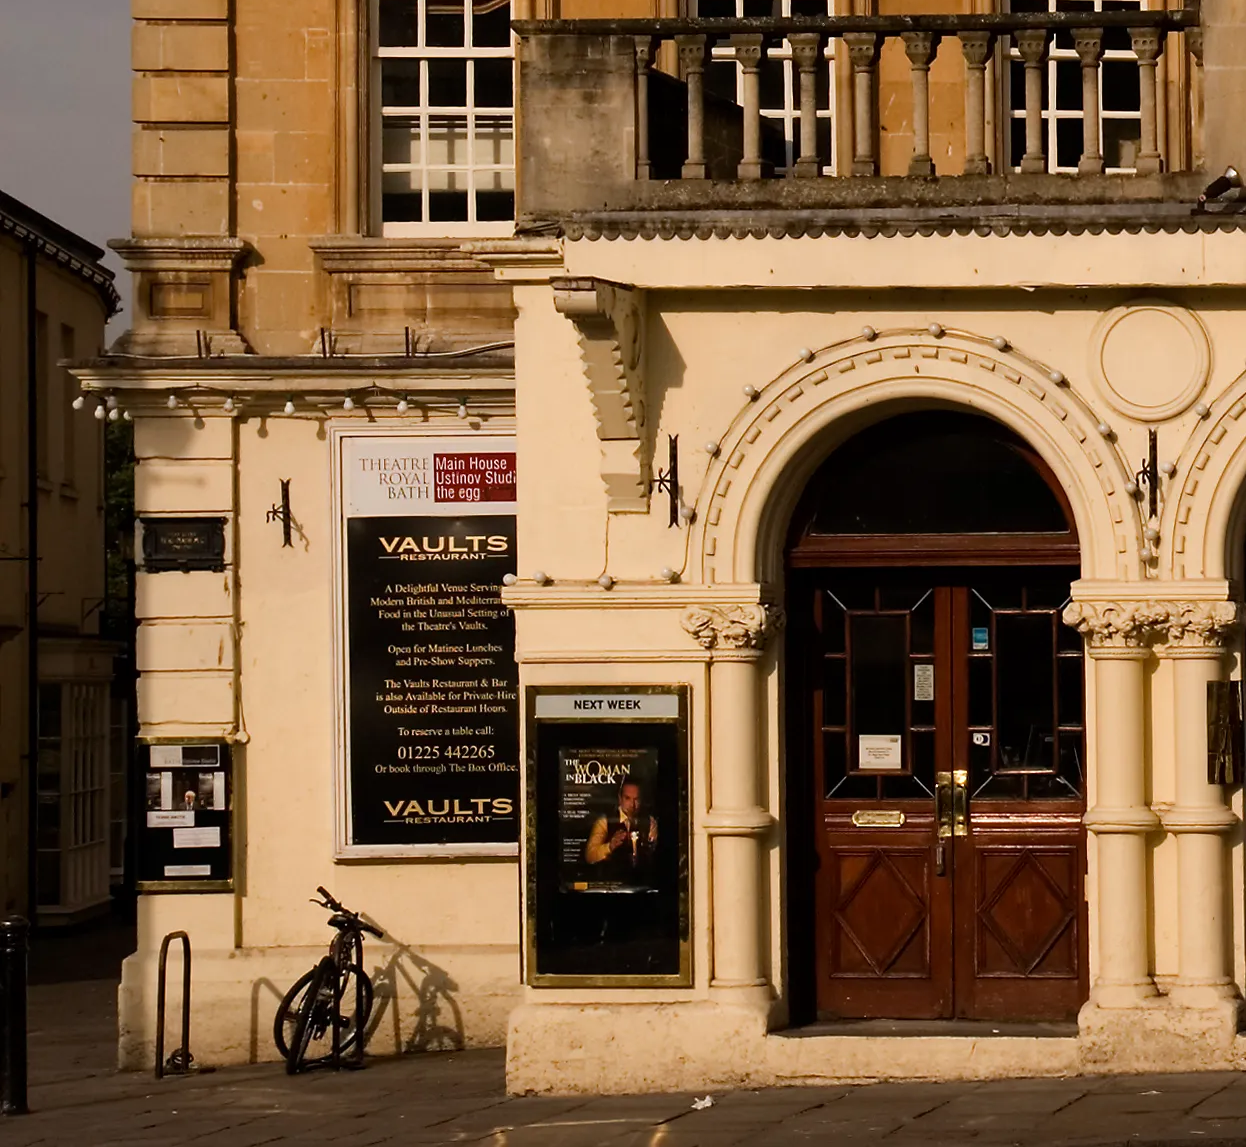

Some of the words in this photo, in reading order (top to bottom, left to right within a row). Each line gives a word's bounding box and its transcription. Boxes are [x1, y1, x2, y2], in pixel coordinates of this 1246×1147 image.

[359, 457, 429, 471] THEATRE
[436, 457, 465, 470] Main
[469, 456, 507, 470] House
[379, 472, 429, 485] ROYAL
[436, 471, 481, 485] Ustinov
[485, 470, 516, 484] Studi
[388, 486, 429, 499] BATH
[437, 486, 454, 499] the
[458, 488, 480, 501] egg
[378, 535, 508, 552] VAULTS
[400, 553, 487, 561] RESTAURANT
[385, 584, 392, 593] A
[395, 584, 438, 595] Delightful
[441, 584, 468, 593] Venue
[370, 597, 404, 606] Modern
[407, 596, 436, 605] British
[438, 596, 453, 605] and
[378, 610, 400, 619] Food
[403, 609, 411, 618] in
[413, 609, 427, 618] the
[429, 609, 465, 618] Unusual
[467, 608, 498, 619] Setting
[500, 608, 509, 617] of
[402, 622, 415, 631] the
[418, 621, 456, 631] Theatre's
[459, 621, 488, 630] Vaults.
[387, 645, 411, 655] Open
[414, 644, 426, 653] for
[428, 644, 463, 653] Matinee
[466, 643, 503, 652] Lunches
[395, 657, 411, 666] and
[413, 657, 455, 666] Pre-Show
[457, 656, 495, 667] Suppers.
[384, 679, 401, 688] The
[404, 679, 430, 688] Vaults
[432, 679, 478, 688] Restaurant
[480, 678, 488, 687] &
[492, 678, 507, 687] Bar
[375, 692, 383, 701] is
[385, 692, 403, 701] also
[405, 691, 446, 701] Available
[448, 691, 461, 700] for
[383, 705, 417, 714] Outside
[420, 704, 429, 713] of
[431, 704, 477, 713] Restaurant
[479, 704, 507, 713] Hours.
[574, 699, 604, 710] NEXT
[607, 699, 641, 710] WEEK
[397, 727, 409, 736] To
[452, 727, 473, 736] table
[475, 726, 494, 735] call:
[397, 746, 440, 759] 01225
[444, 745, 495, 759] 442265
[375, 764, 387, 773] Or
[389, 763, 411, 773] book
[413, 763, 446, 775] through
[449, 763, 466, 772] The
[468, 763, 486, 772] Box
[488, 762, 518, 772] Office.
[575, 760, 631, 778] WOMAN
[575, 773, 616, 784] BLACK
[383, 798, 513, 816] VAULTS
[405, 816, 492, 824] RESTAURANT
